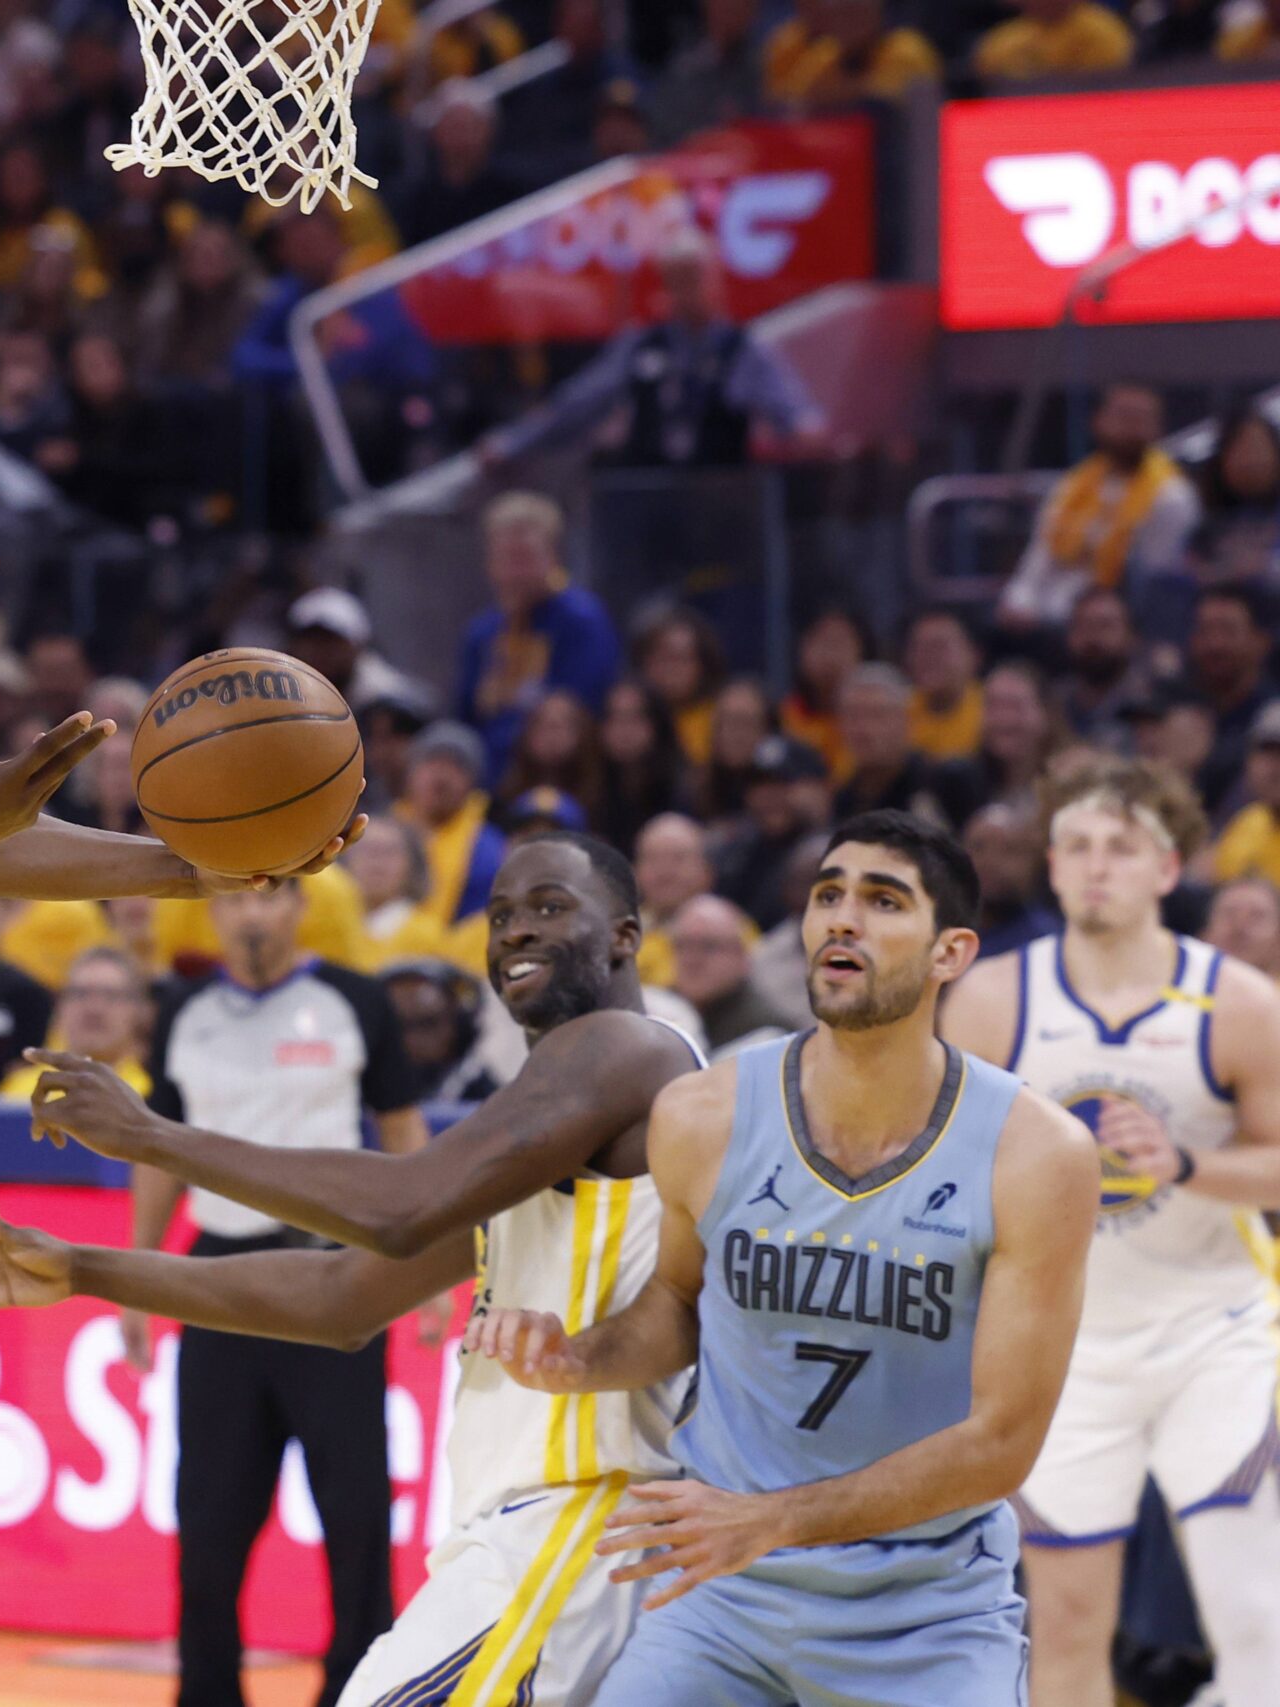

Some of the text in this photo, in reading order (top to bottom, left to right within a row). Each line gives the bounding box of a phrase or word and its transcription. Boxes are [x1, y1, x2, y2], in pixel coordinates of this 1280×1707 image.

[153, 670, 305, 728] Wilson
[903, 1216, 966, 1238] Robinhood
[723, 1229, 955, 1342] GRIZZLIES
[794, 1341, 873, 1431] 7
